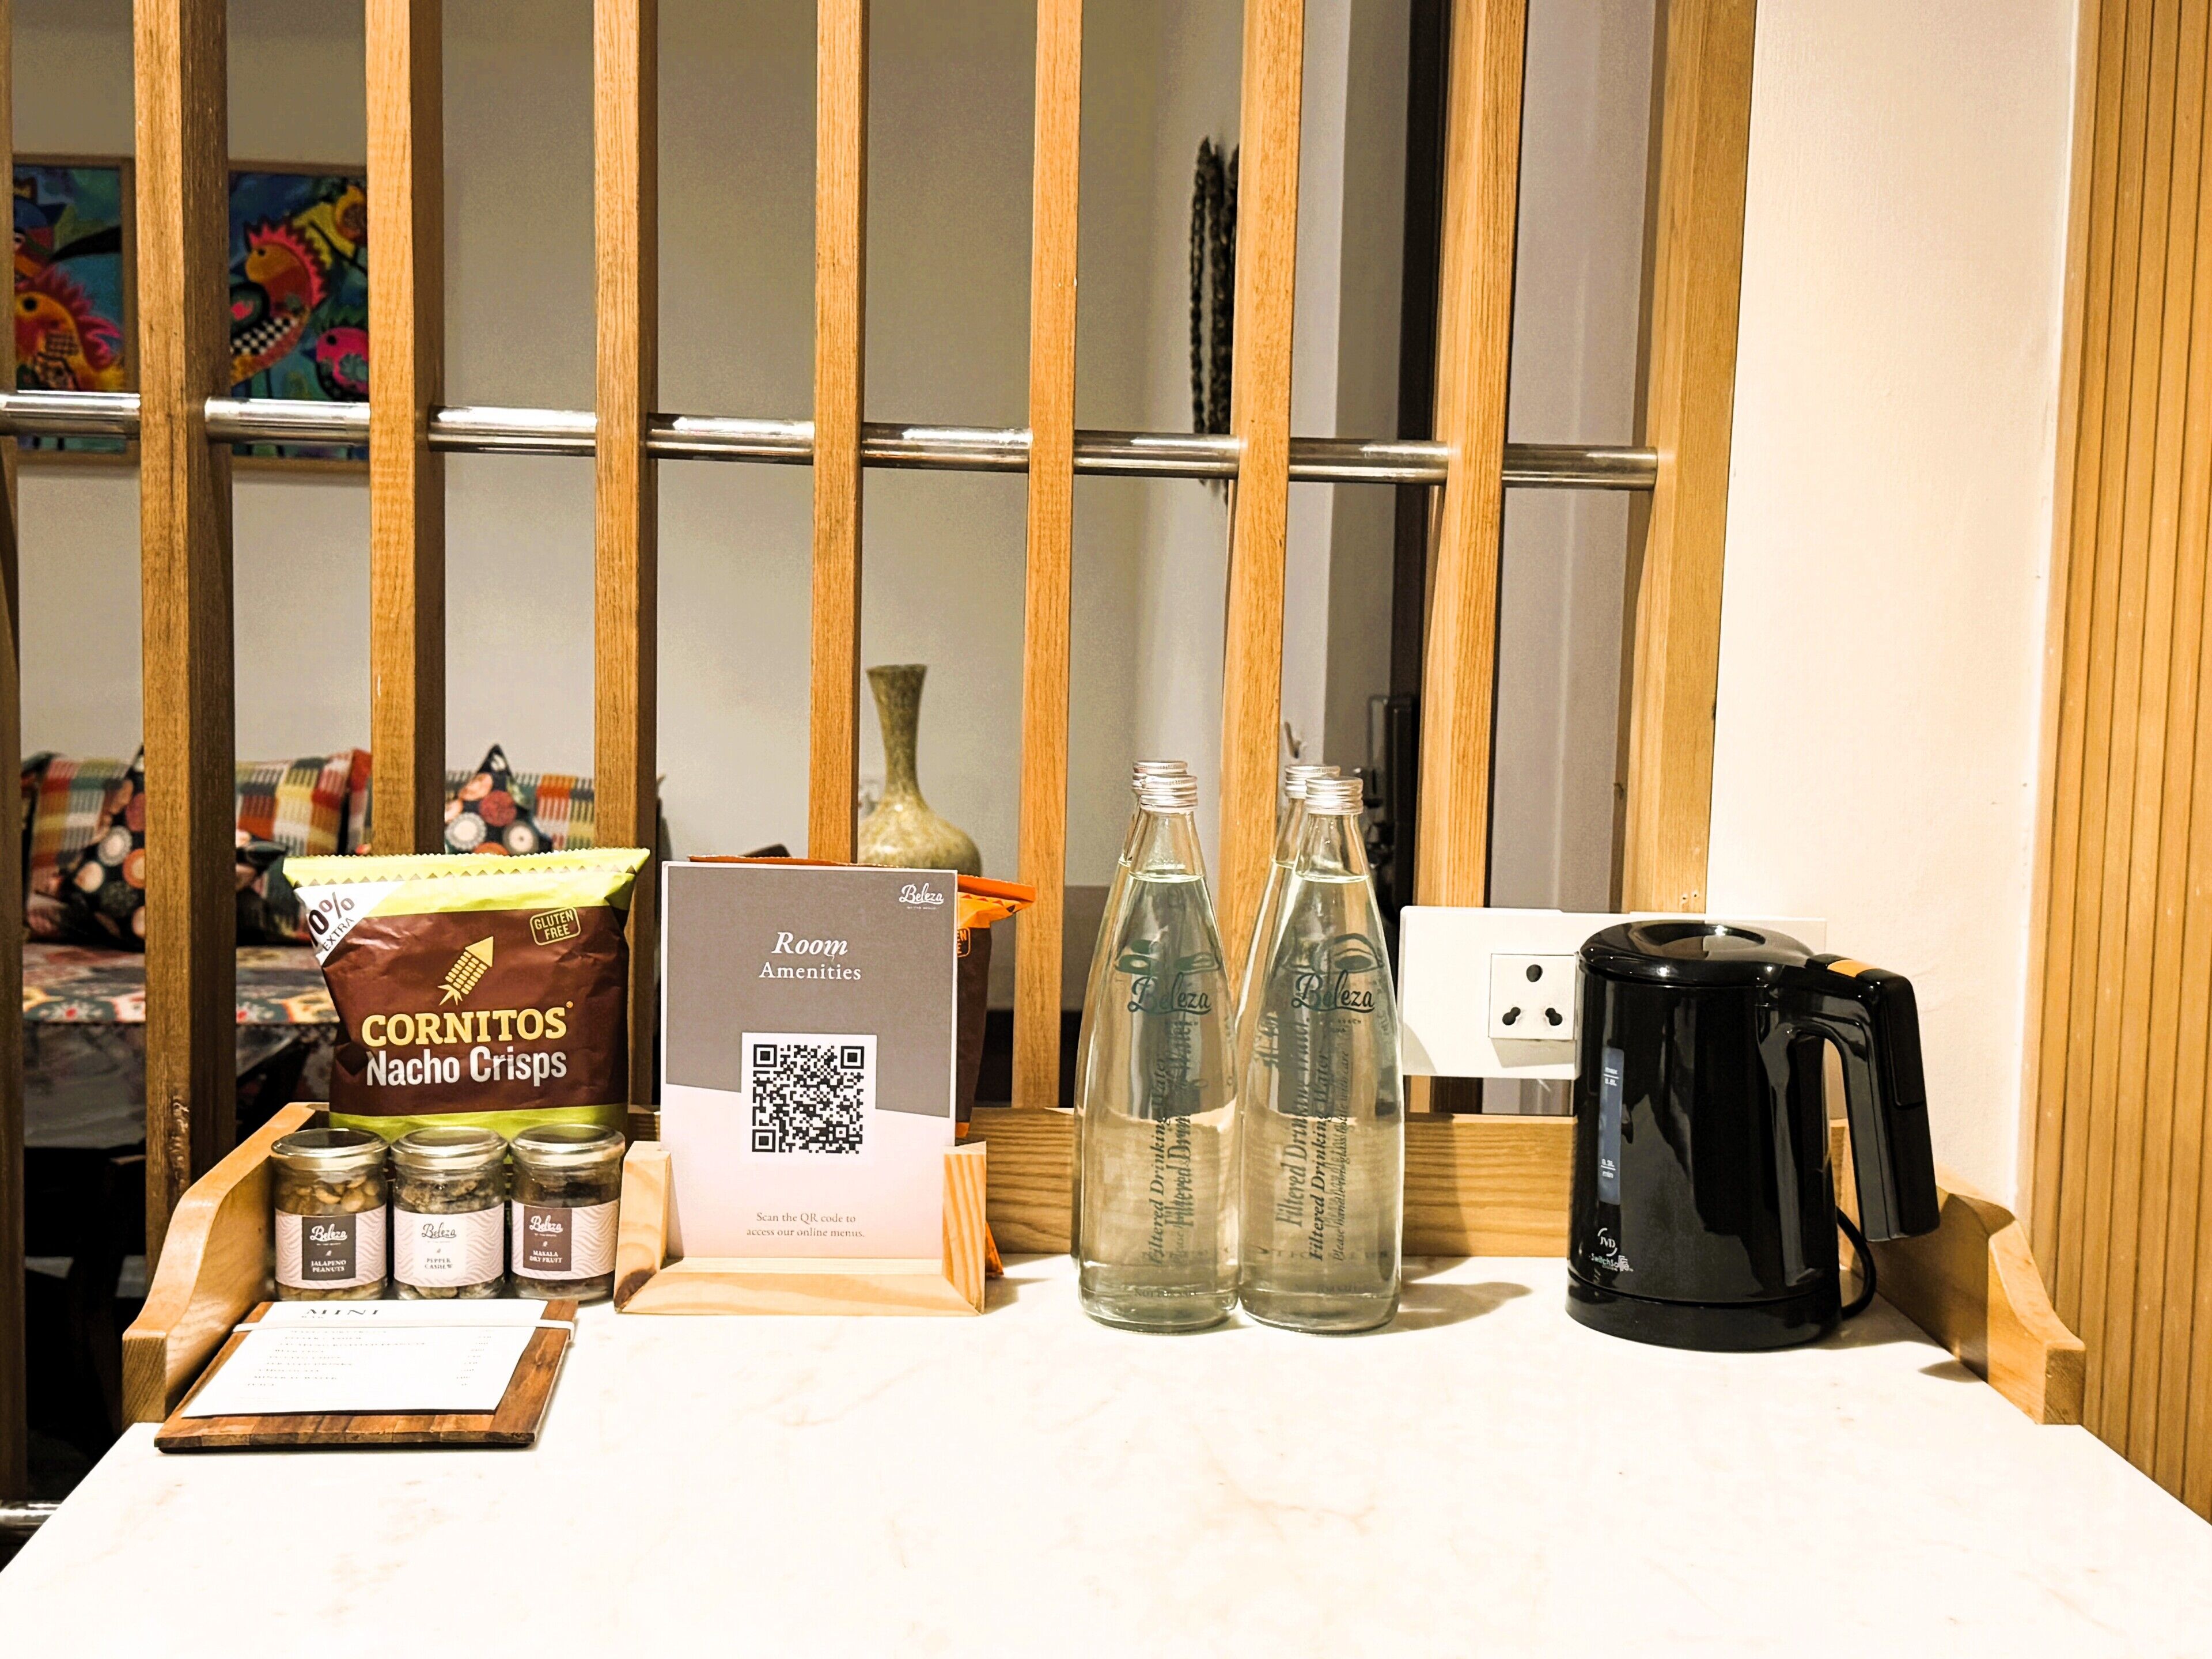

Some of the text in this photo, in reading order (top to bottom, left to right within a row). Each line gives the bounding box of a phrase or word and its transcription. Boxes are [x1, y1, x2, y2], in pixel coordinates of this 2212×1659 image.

[899, 883, 944, 904] Beleza
[309, 892, 355, 948] 0%
[323, 918, 355, 951] EXTRA
[534, 910, 574, 930] GLUTEN
[544, 924, 570, 940] FREE
[771, 932, 848, 962] Room
[759, 961, 861, 980] Amenities
[1127, 972, 1211, 1015] Beleza
[1291, 969, 1375, 1013] Beleza
[362, 1007, 567, 1047] CORNITOS
[366, 1046, 567, 1086] Nacho Crisps
[1150, 1118, 1170, 1195] Drinking
[1311, 1115, 1331, 1192] Drinking
[1275, 1162, 1305, 1226] Filtered
[309, 1223, 348, 1241] Beleza
[421, 1222, 457, 1238] Beleza
[529, 1215, 563, 1233] Beleza
[756, 1212, 856, 1225] Scan the QR code to
[797, 1228, 828, 1237] online
[1148, 1199, 1164, 1264] Filtered
[1309, 1194, 1325, 1260] Filtered
[1332, 1227, 1344, 1260] Please
